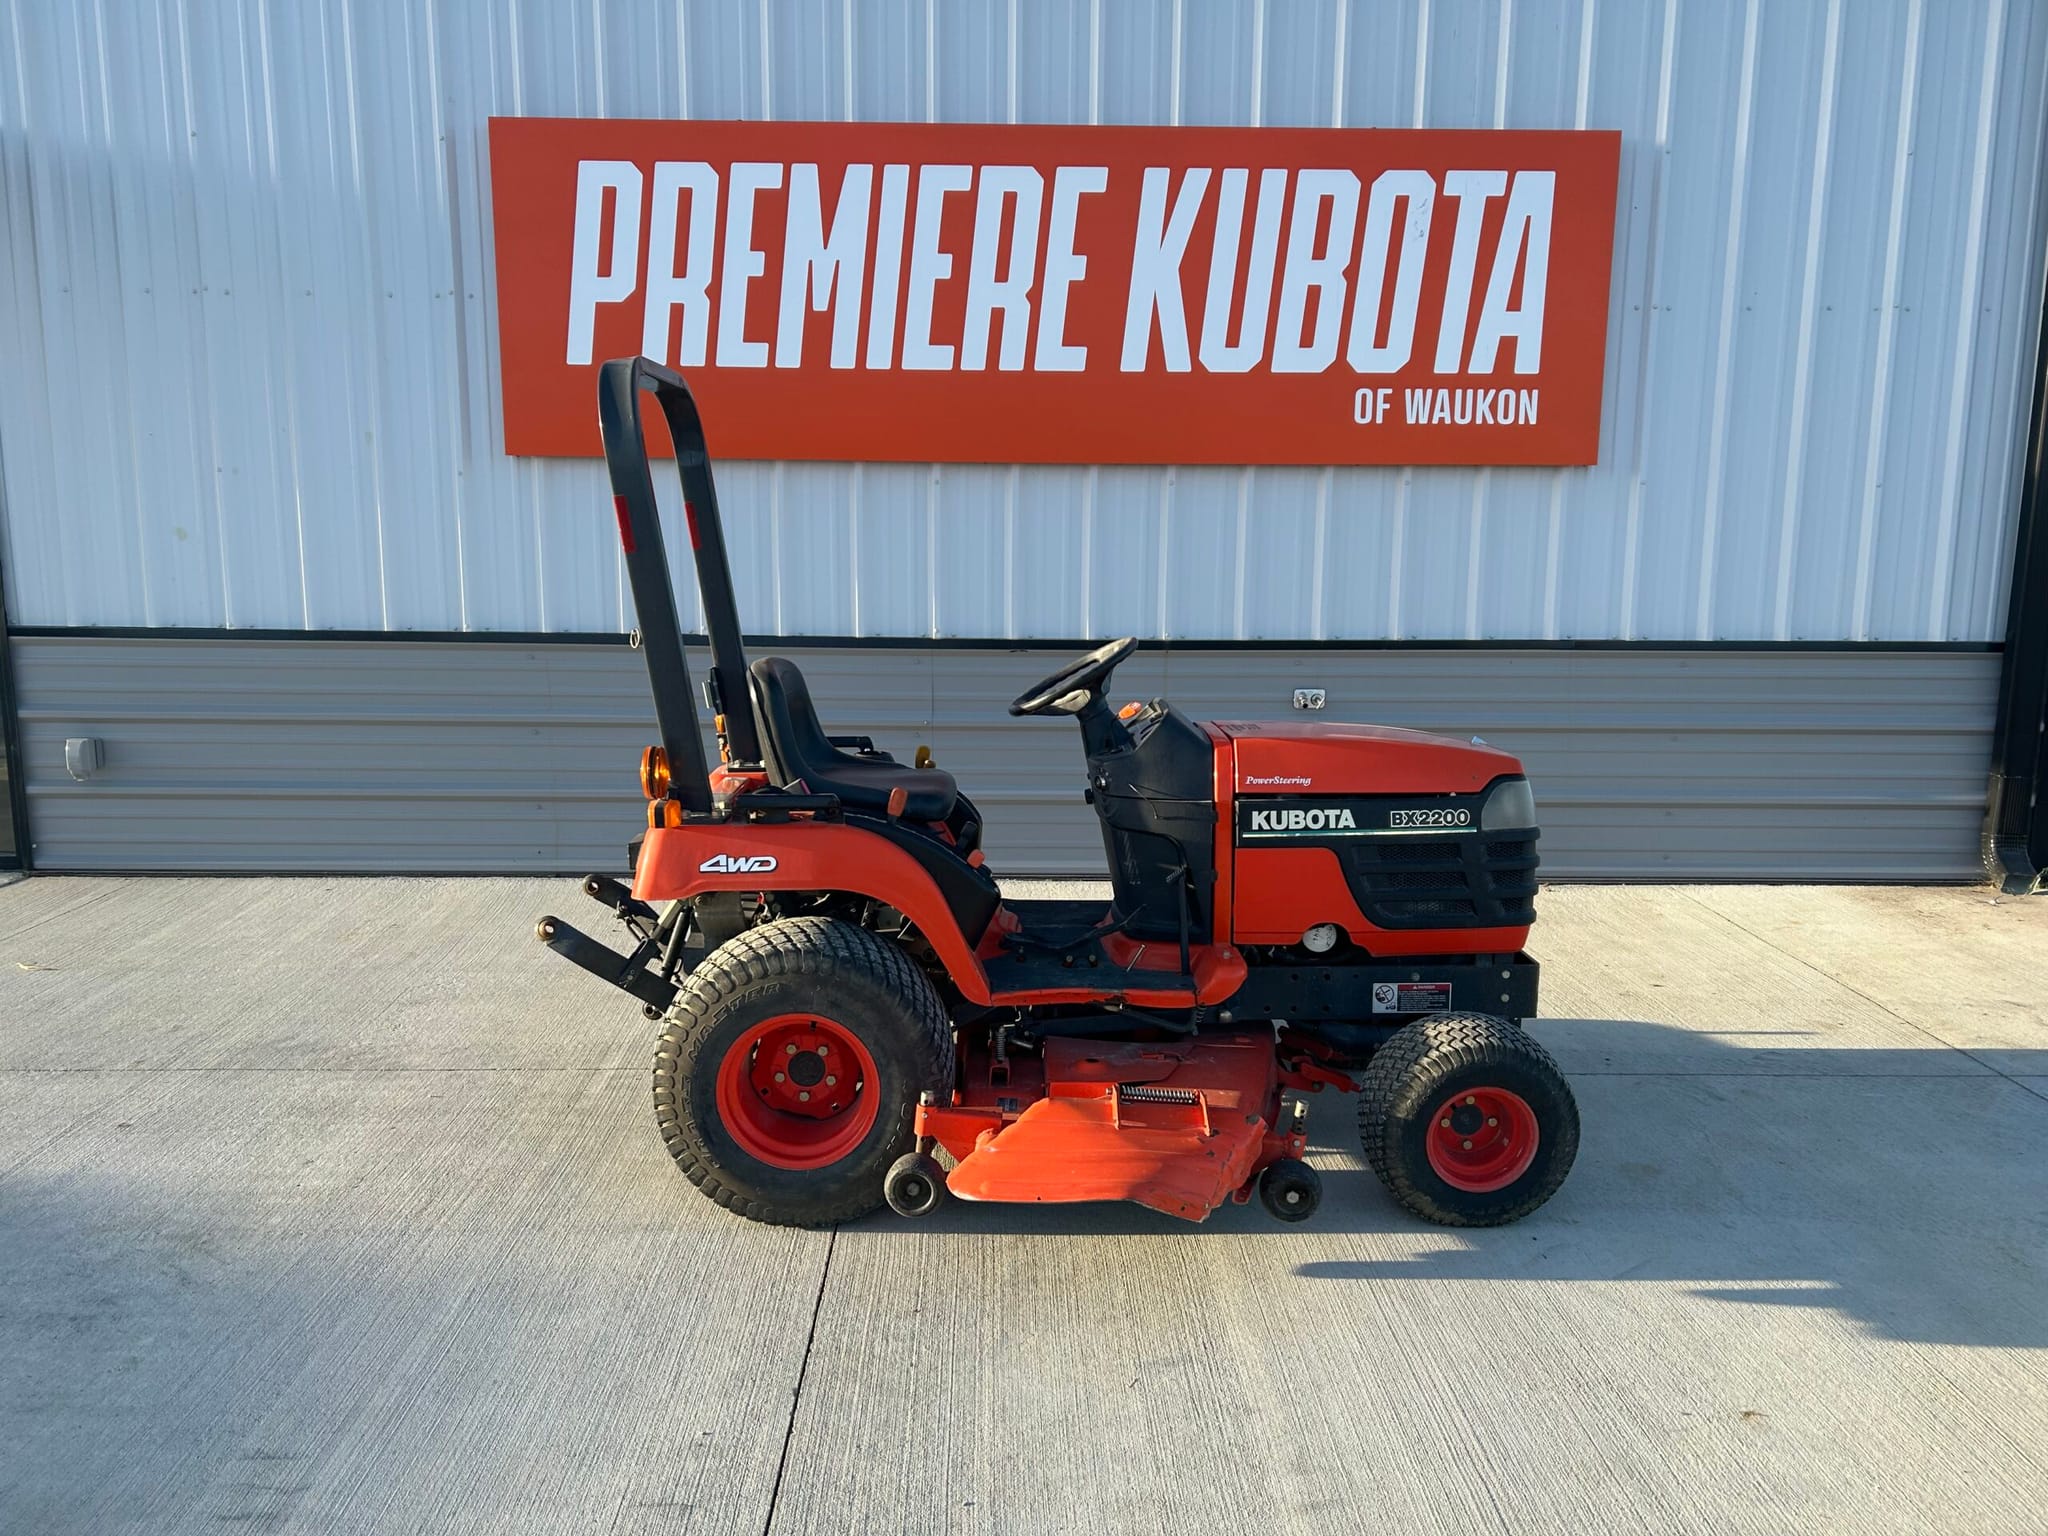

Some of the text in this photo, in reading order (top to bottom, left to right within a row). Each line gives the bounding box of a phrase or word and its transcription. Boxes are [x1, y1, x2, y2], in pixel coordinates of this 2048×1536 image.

[566, 159, 1557, 375] PREMIERE KUBOTA
[1354, 387, 1539, 426] OF WAUKON
[1244, 775, 1312, 787] PowerSteering
[1251, 808, 1471, 831] KUBOTA BX2200
[699, 854, 778, 873] 4WD
[687, 983, 780, 1062] MASTER
